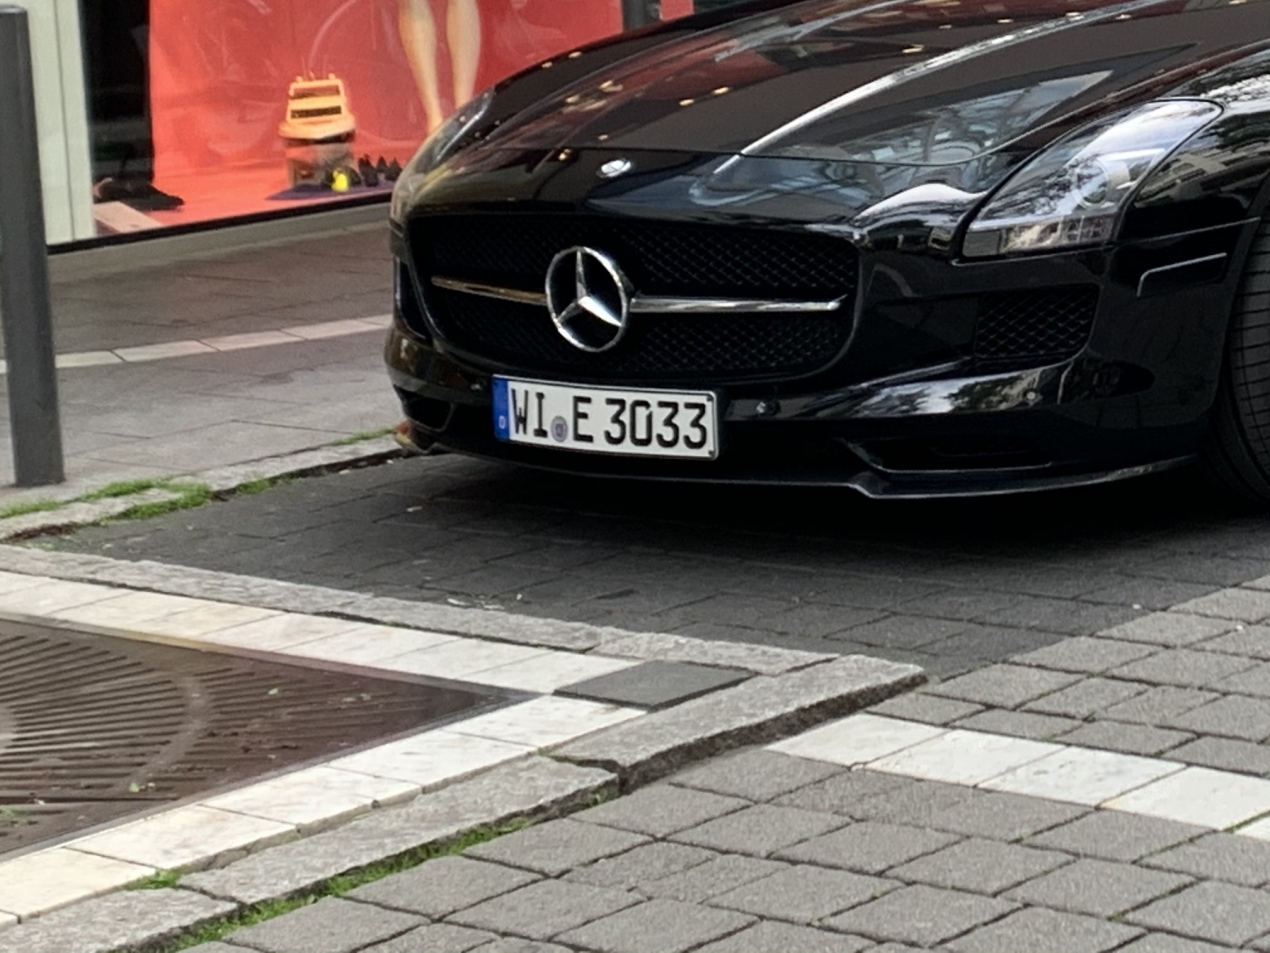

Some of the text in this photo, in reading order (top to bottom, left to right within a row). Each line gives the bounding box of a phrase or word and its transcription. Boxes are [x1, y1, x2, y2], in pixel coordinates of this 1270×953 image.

[511, 388, 548, 438] WI
[572, 395, 594, 443] E
[604, 398, 708, 450] 3033
